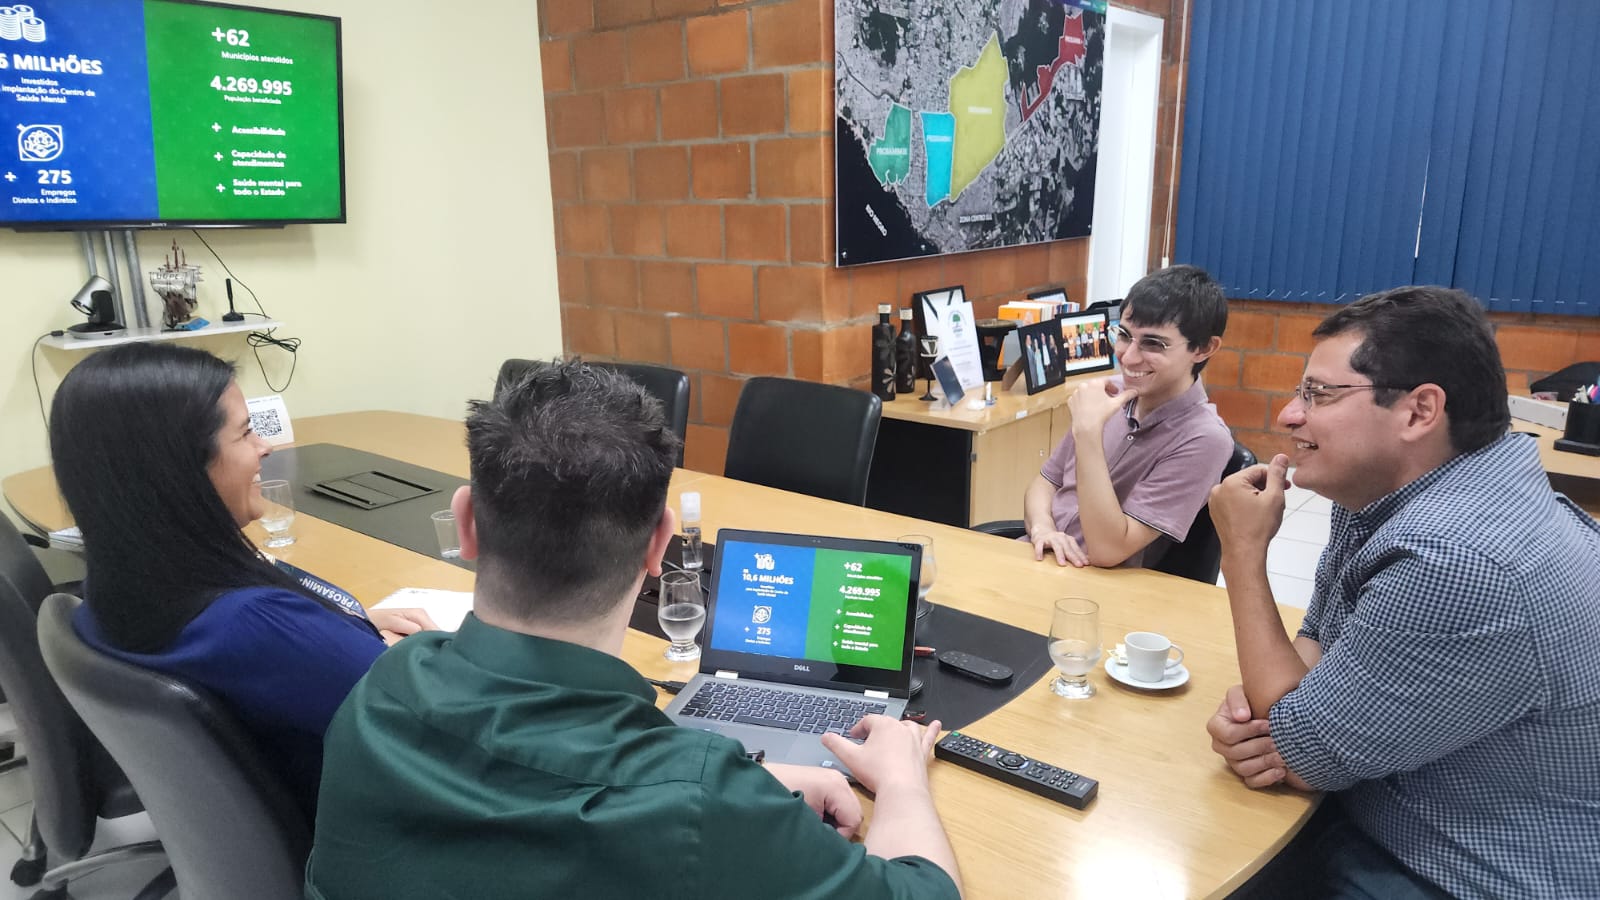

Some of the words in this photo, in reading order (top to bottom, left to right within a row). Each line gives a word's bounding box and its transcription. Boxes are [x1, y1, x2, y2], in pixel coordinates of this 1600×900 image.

[211, 26, 250, 47] +62
[13, 54, 103, 75] MILHÕES
[260, 55, 294, 65] atendidos
[21, 77, 58, 86] Investidos
[210, 75, 292, 96] 4.269.995
[49, 87, 60, 95] do
[60, 88, 85, 97] Centro
[85, 89, 96, 97] de
[40, 95, 67, 103] Mental
[231, 149, 275, 160] Capacidade
[276, 151, 287, 159] de
[37, 169, 73, 185] 275
[257, 178, 284, 187] mental
[285, 181, 302, 189] para
[41, 188, 76, 197] Empregos
[233, 188, 253, 196] todo
[260, 188, 286, 196] Estado
[12, 196, 39, 204] Diretos
[46, 196, 77, 204] Indiretos
[843, 561, 863, 573] +62
[758, 574, 795, 585] MILHÕES
[839, 585, 881, 597] 4.269.995
[756, 626, 772, 635] 275
[794, 664, 810, 672] DELL
